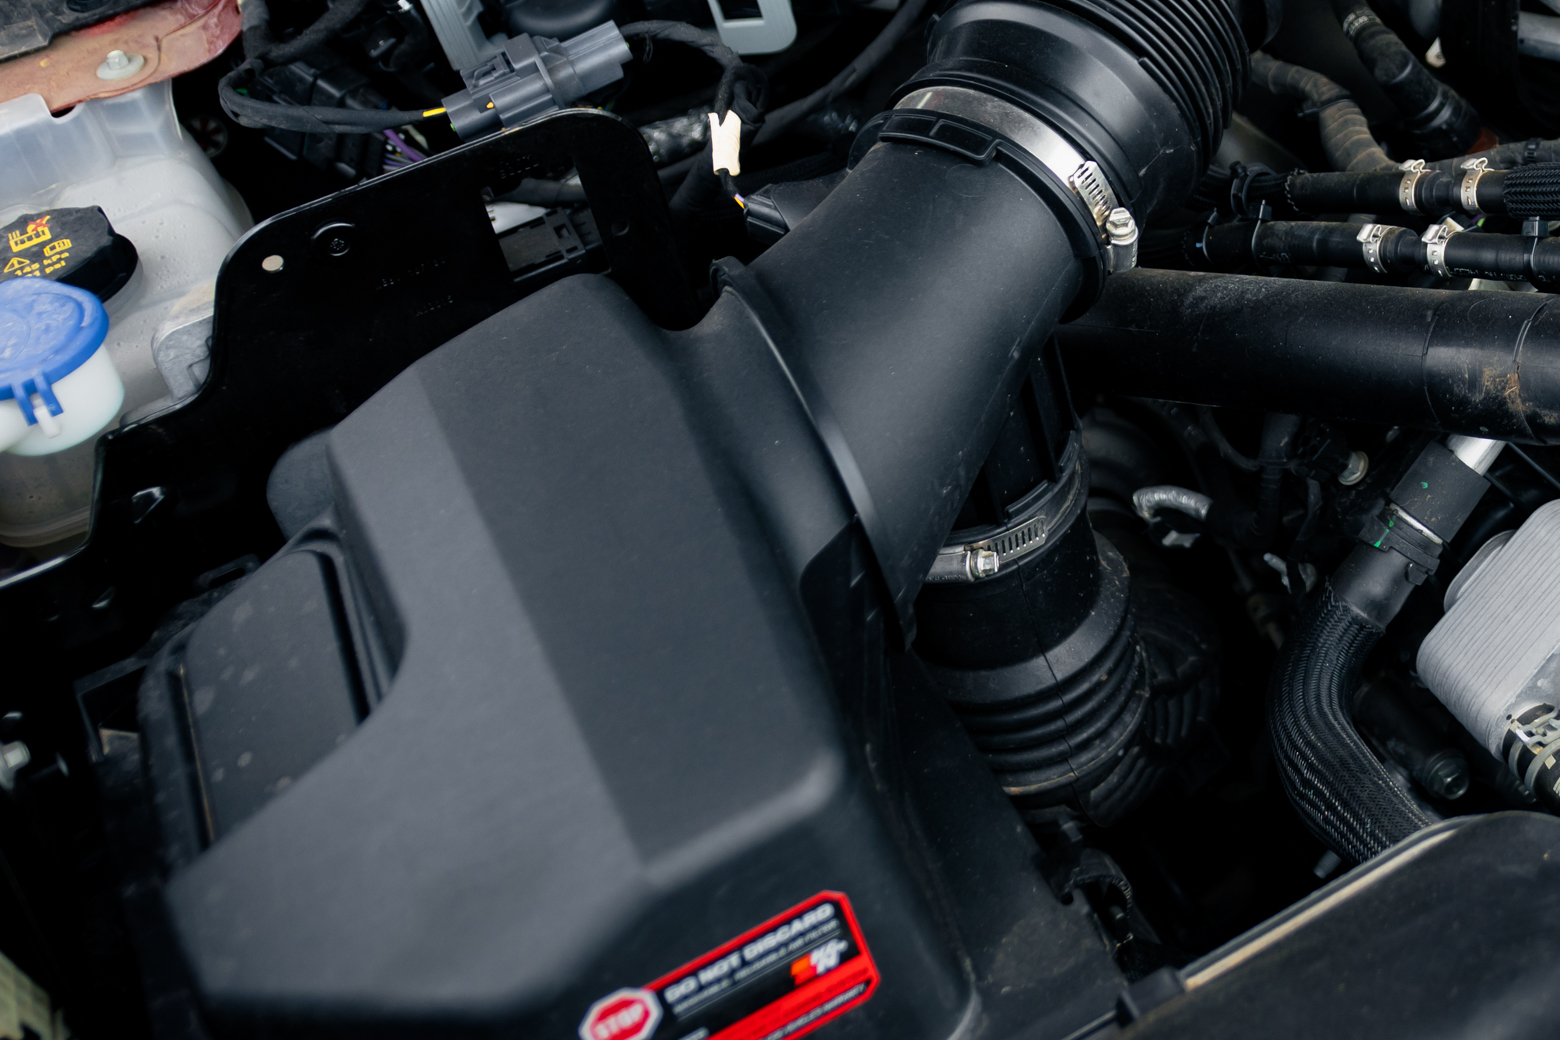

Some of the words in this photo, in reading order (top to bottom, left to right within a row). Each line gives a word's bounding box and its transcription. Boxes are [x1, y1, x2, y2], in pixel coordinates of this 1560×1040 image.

[14, 262, 40, 277] 145
[43, 252, 70, 266] kPa
[45, 260, 66, 274] psi
[664, 976, 698, 1004] DO
[697, 952, 742, 985] NOT
[742, 903, 835, 962] DISCARD
[593, 1002, 645, 1040] STOP
